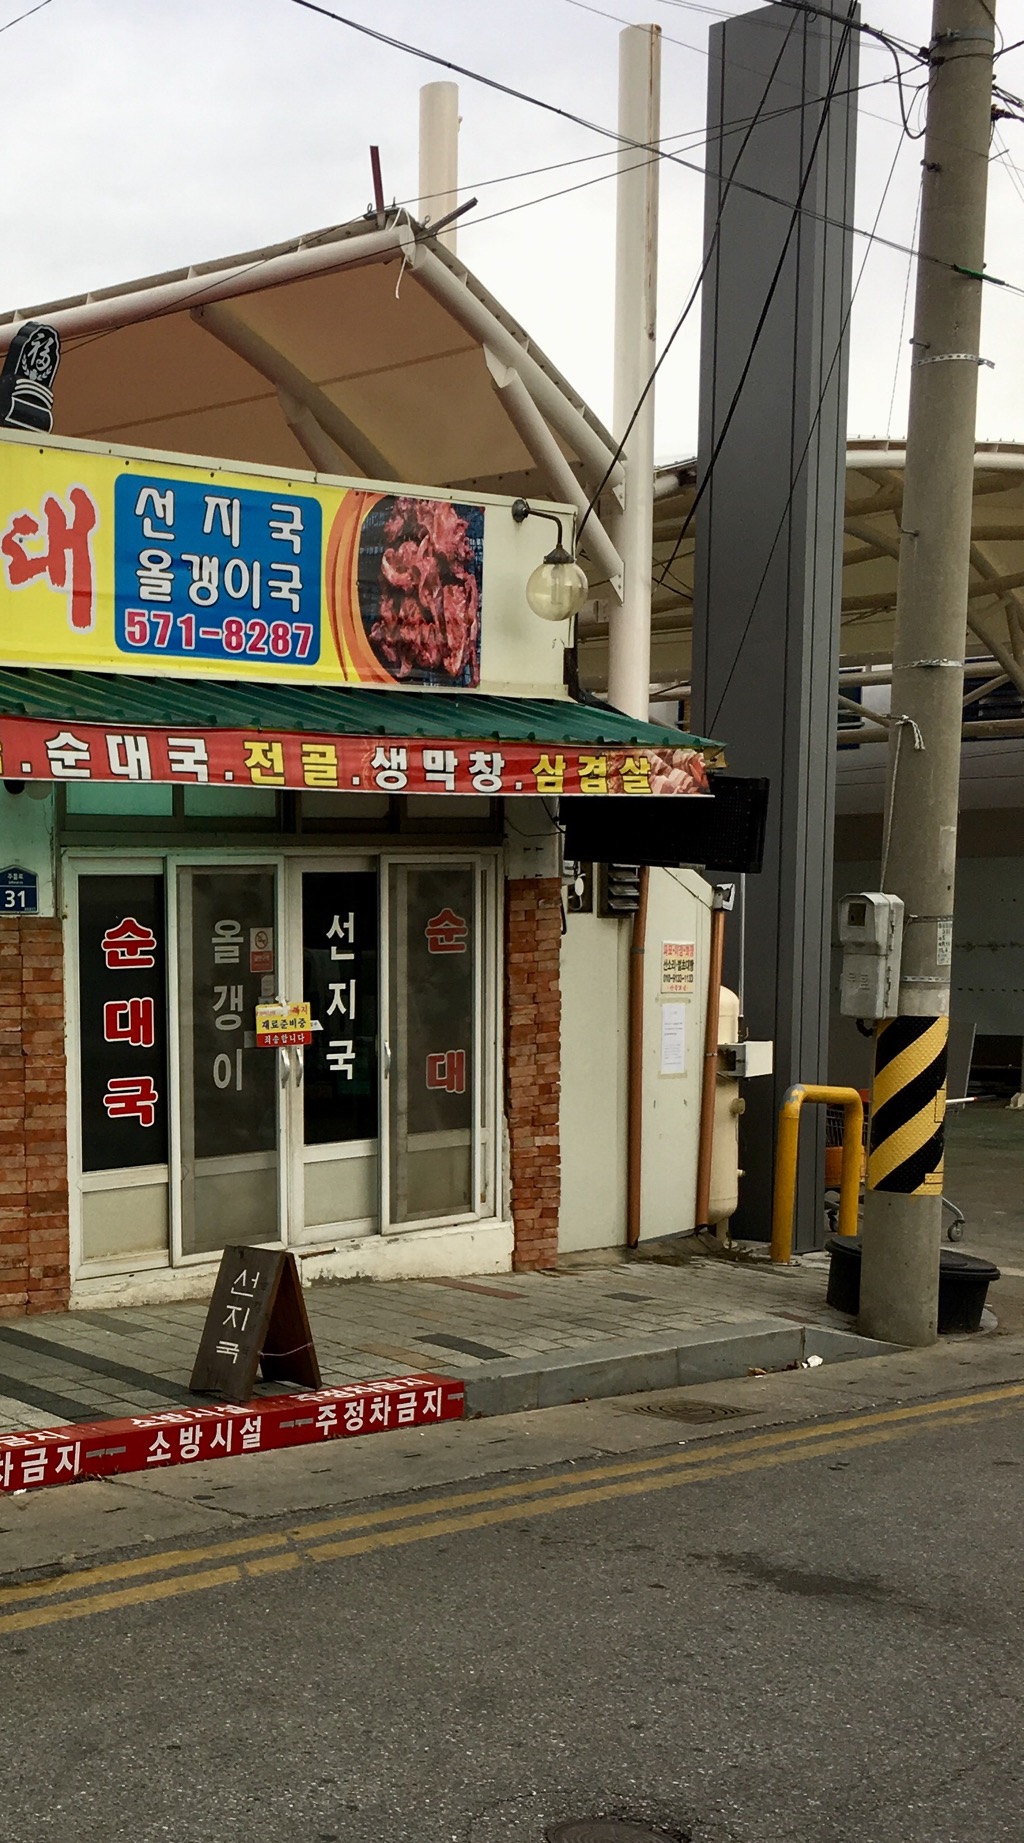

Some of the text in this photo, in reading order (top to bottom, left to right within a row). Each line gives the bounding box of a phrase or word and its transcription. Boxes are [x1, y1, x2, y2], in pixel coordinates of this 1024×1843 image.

[134, 486, 304, 555] 선지국
[135, 548, 303, 613] 올갱이국
[125, 608, 314, 658] 571-8287
[531, 752, 654, 794] 삼겹살
[4, 890, 25, 908] 31
[101, 917, 158, 1127] 순대국
[211, 919, 244, 1091] 올갱이
[326, 912, 356, 1080] 선지국
[425, 907, 468, 1093] 순대
[264, 1033, 305, 1045] 죄송합니다
[216, 1268, 260, 1364] 선지국
[146, 1416, 262, 1462] 소방시설
[314, 1386, 443, 1436] 주정차금지
